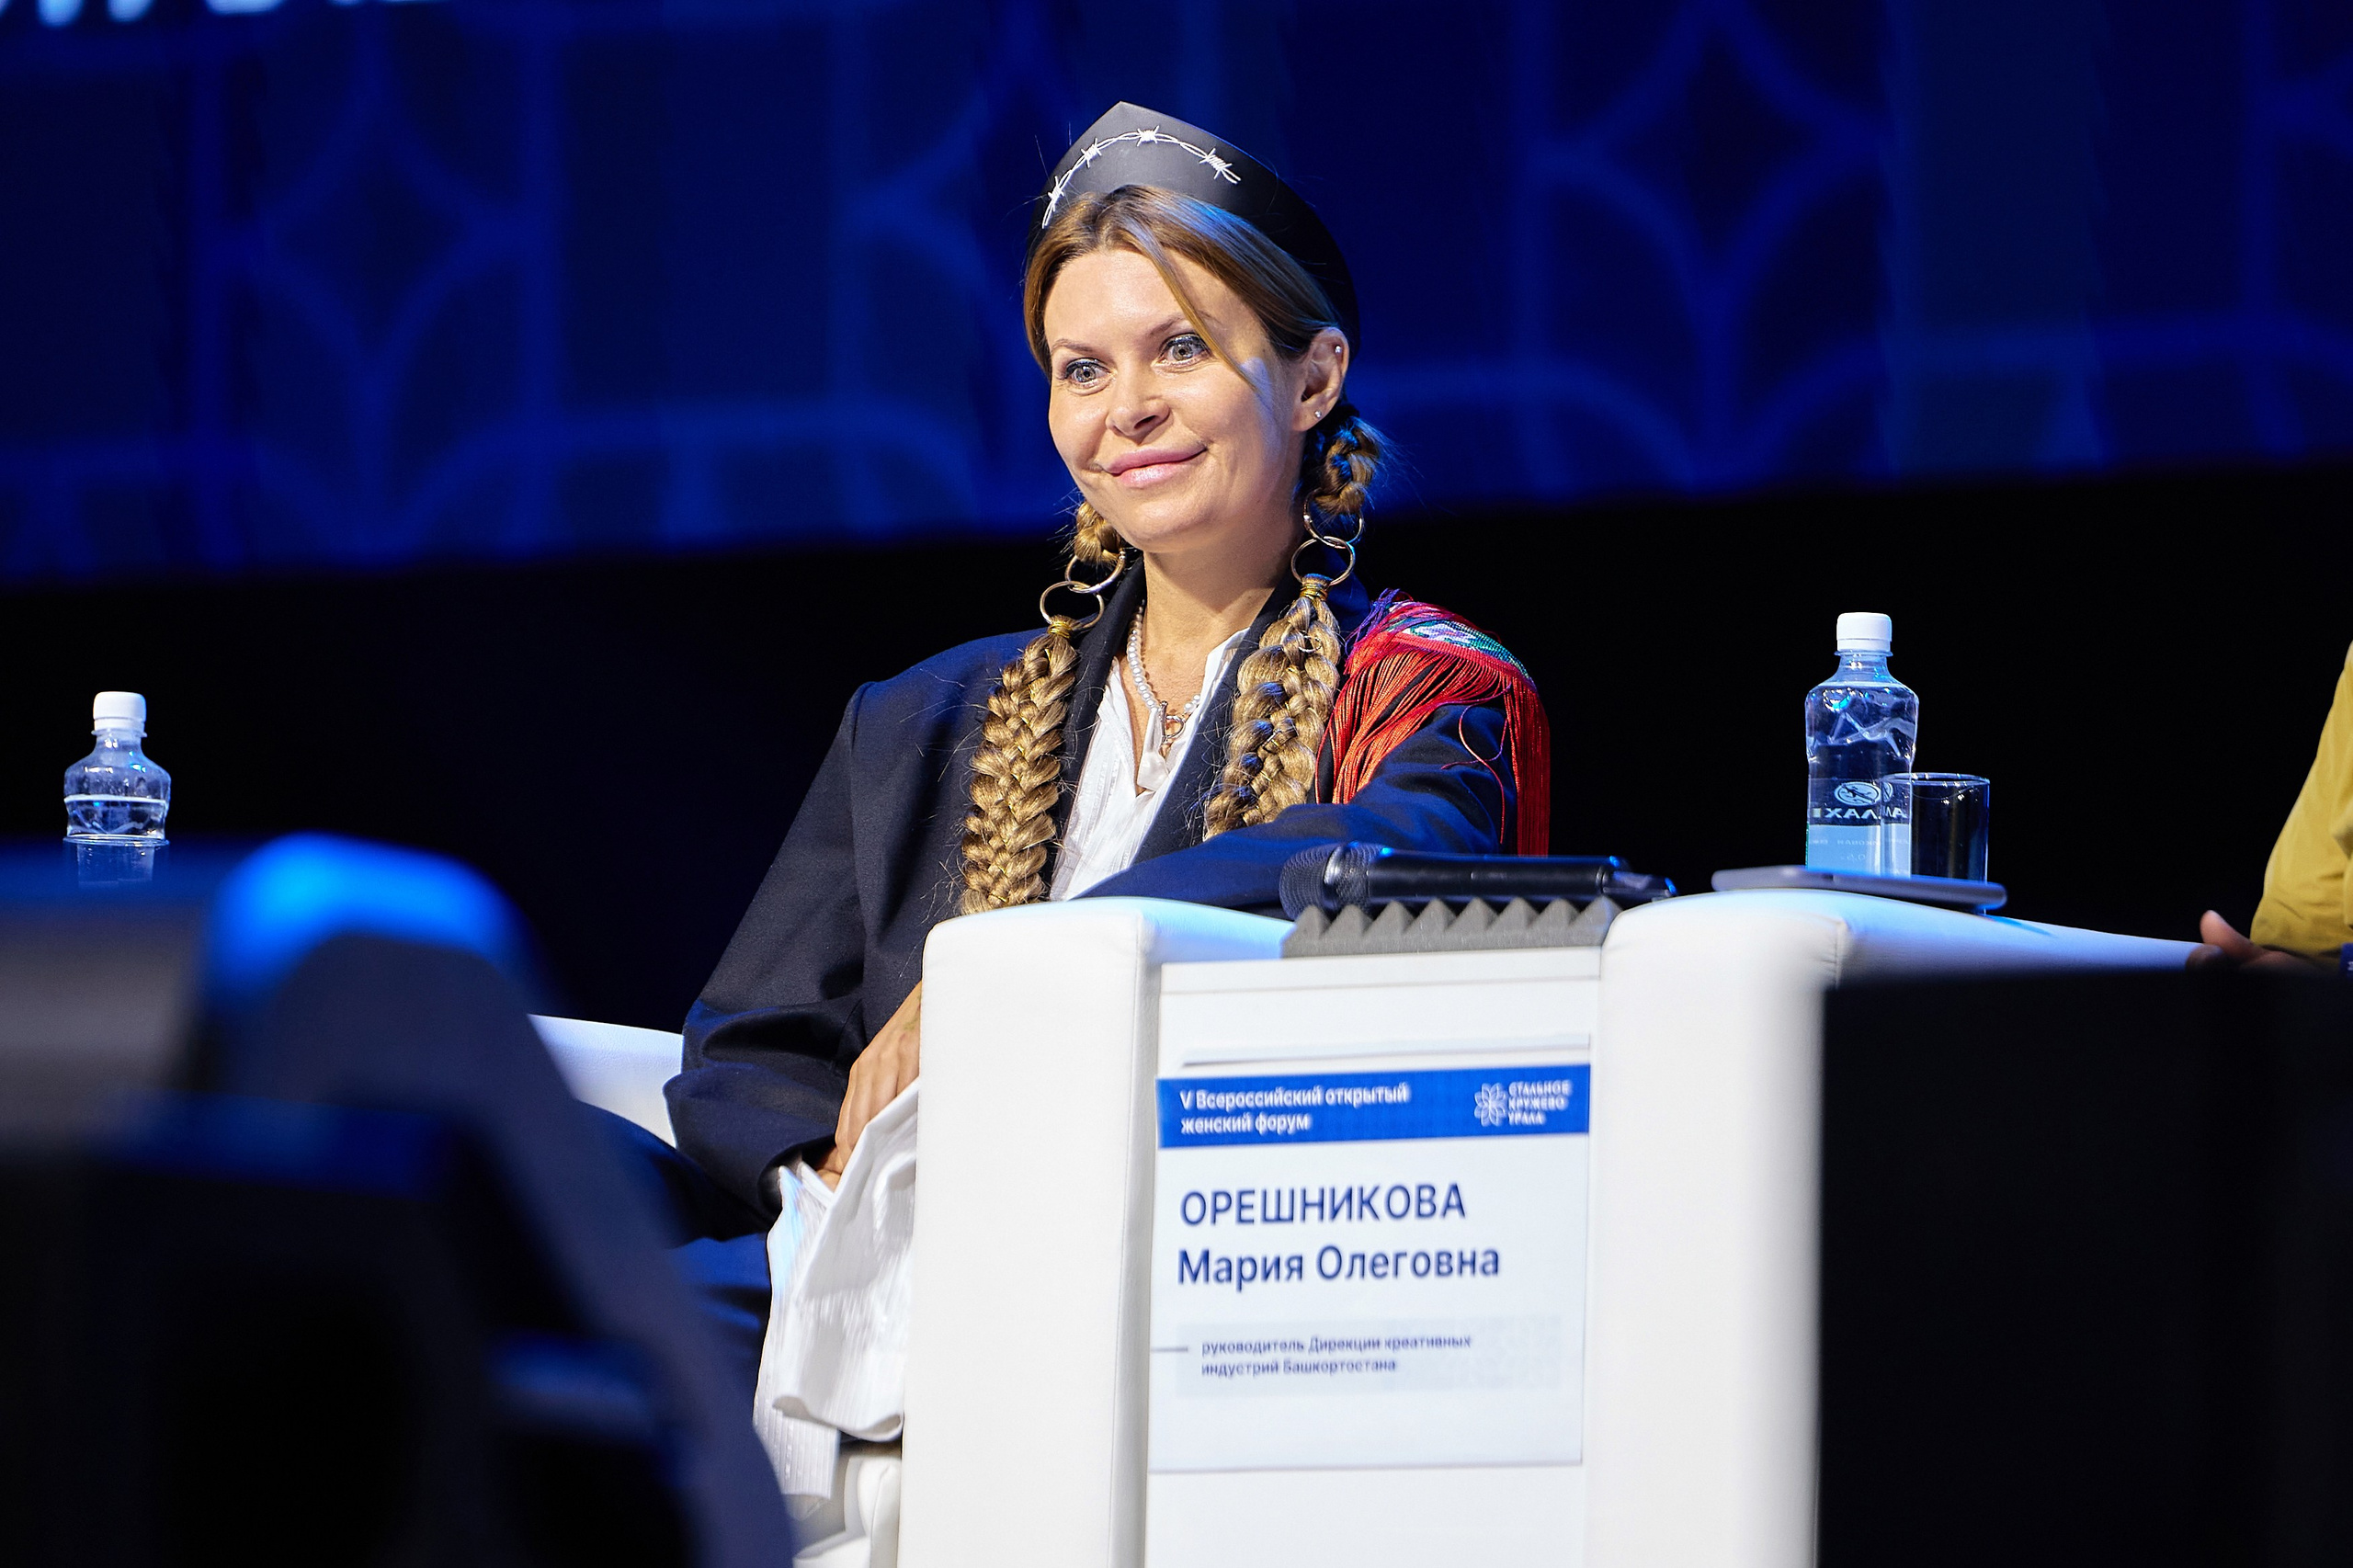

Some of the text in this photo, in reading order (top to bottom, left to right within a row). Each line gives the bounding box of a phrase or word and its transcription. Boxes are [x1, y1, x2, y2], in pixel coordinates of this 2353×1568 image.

[1179, 1082, 1412, 1112] V Всероссийский открытый
[1508, 1079, 1572, 1096] СТАЛЬНОЕ
[1508, 1096, 1568, 1111] КРУЖЕВО
[1180, 1111, 1312, 1136] женский форум
[1507, 1110, 1546, 1126] УРАЛА
[1180, 1182, 1466, 1226] ОРЕШНИКОВА
[1177, 1244, 1500, 1293] Мария Олеговна
[1201, 1335, 1472, 1358] руководитель Дирекции креативных
[1201, 1358, 1396, 1379] индустрий Башкортостана
